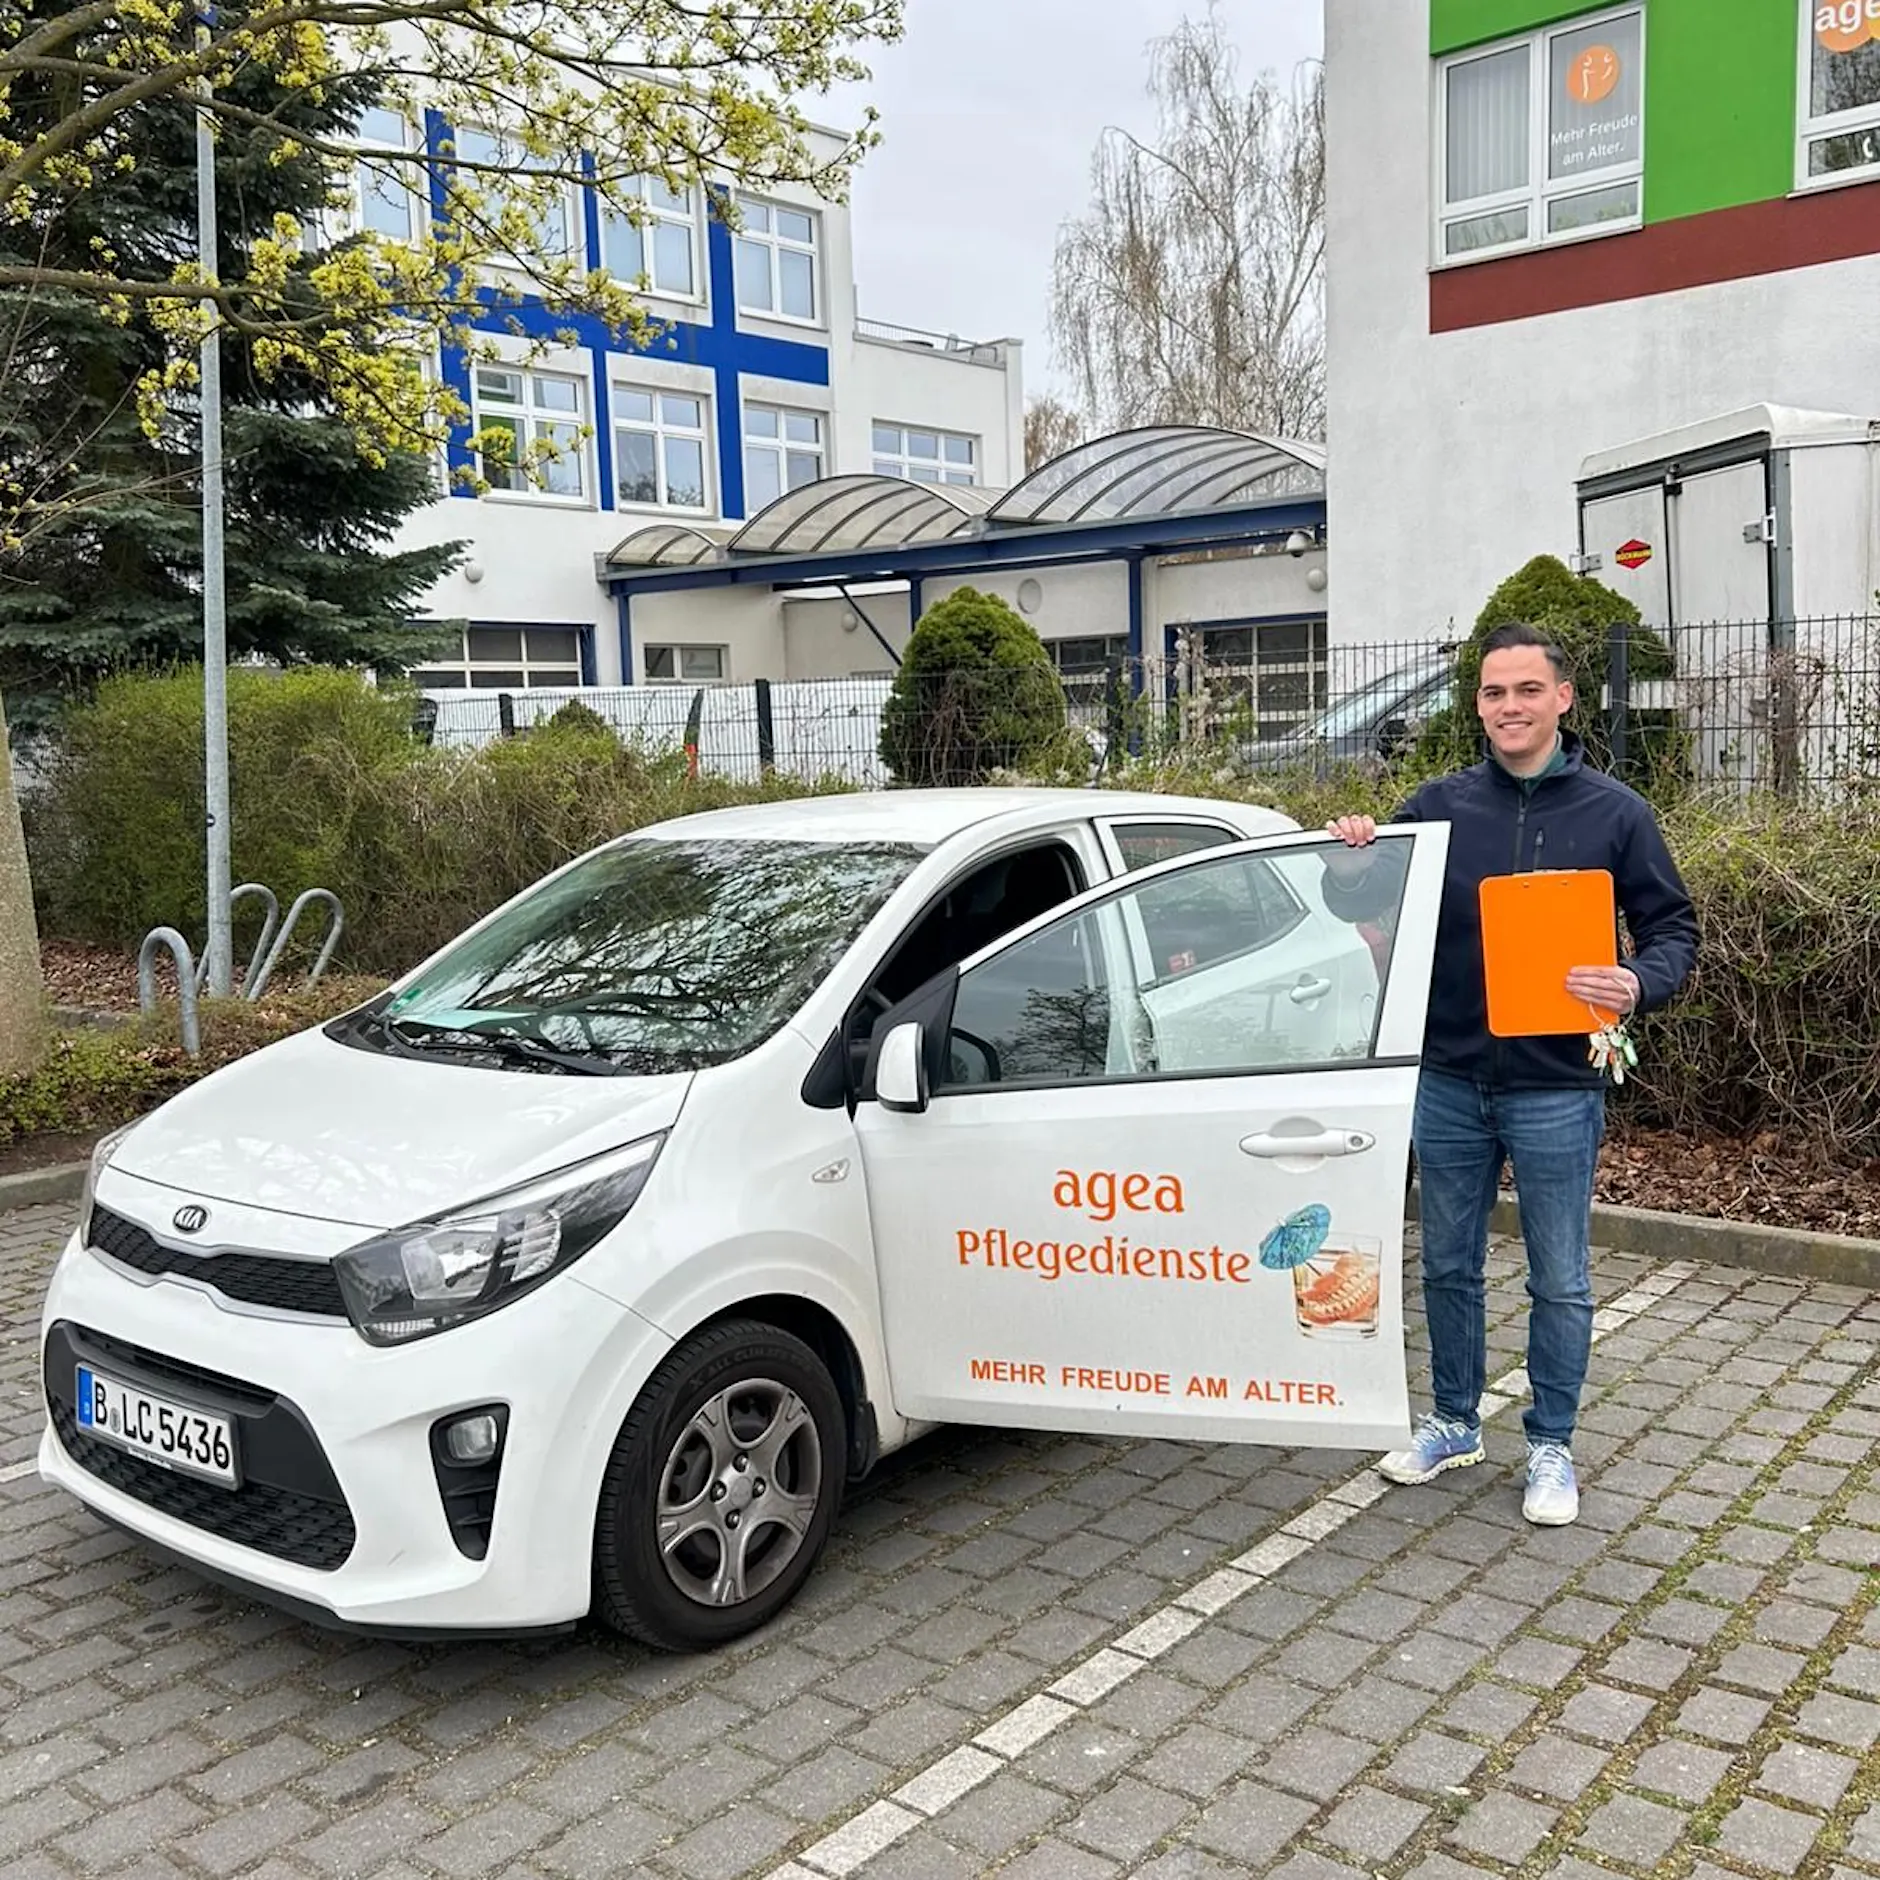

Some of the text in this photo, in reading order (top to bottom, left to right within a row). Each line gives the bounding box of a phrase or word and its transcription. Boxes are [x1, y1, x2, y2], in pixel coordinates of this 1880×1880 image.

[1552, 114, 1638, 146] Mehr Freude
[1562, 151, 1584, 166] am
[1054, 1169, 1185, 1221] agea
[175, 1208, 203, 1229] KIA
[957, 1229, 1251, 1283] Pflegedienste
[970, 1359, 1345, 1406] MEHR FREUDE AM ALTER.
